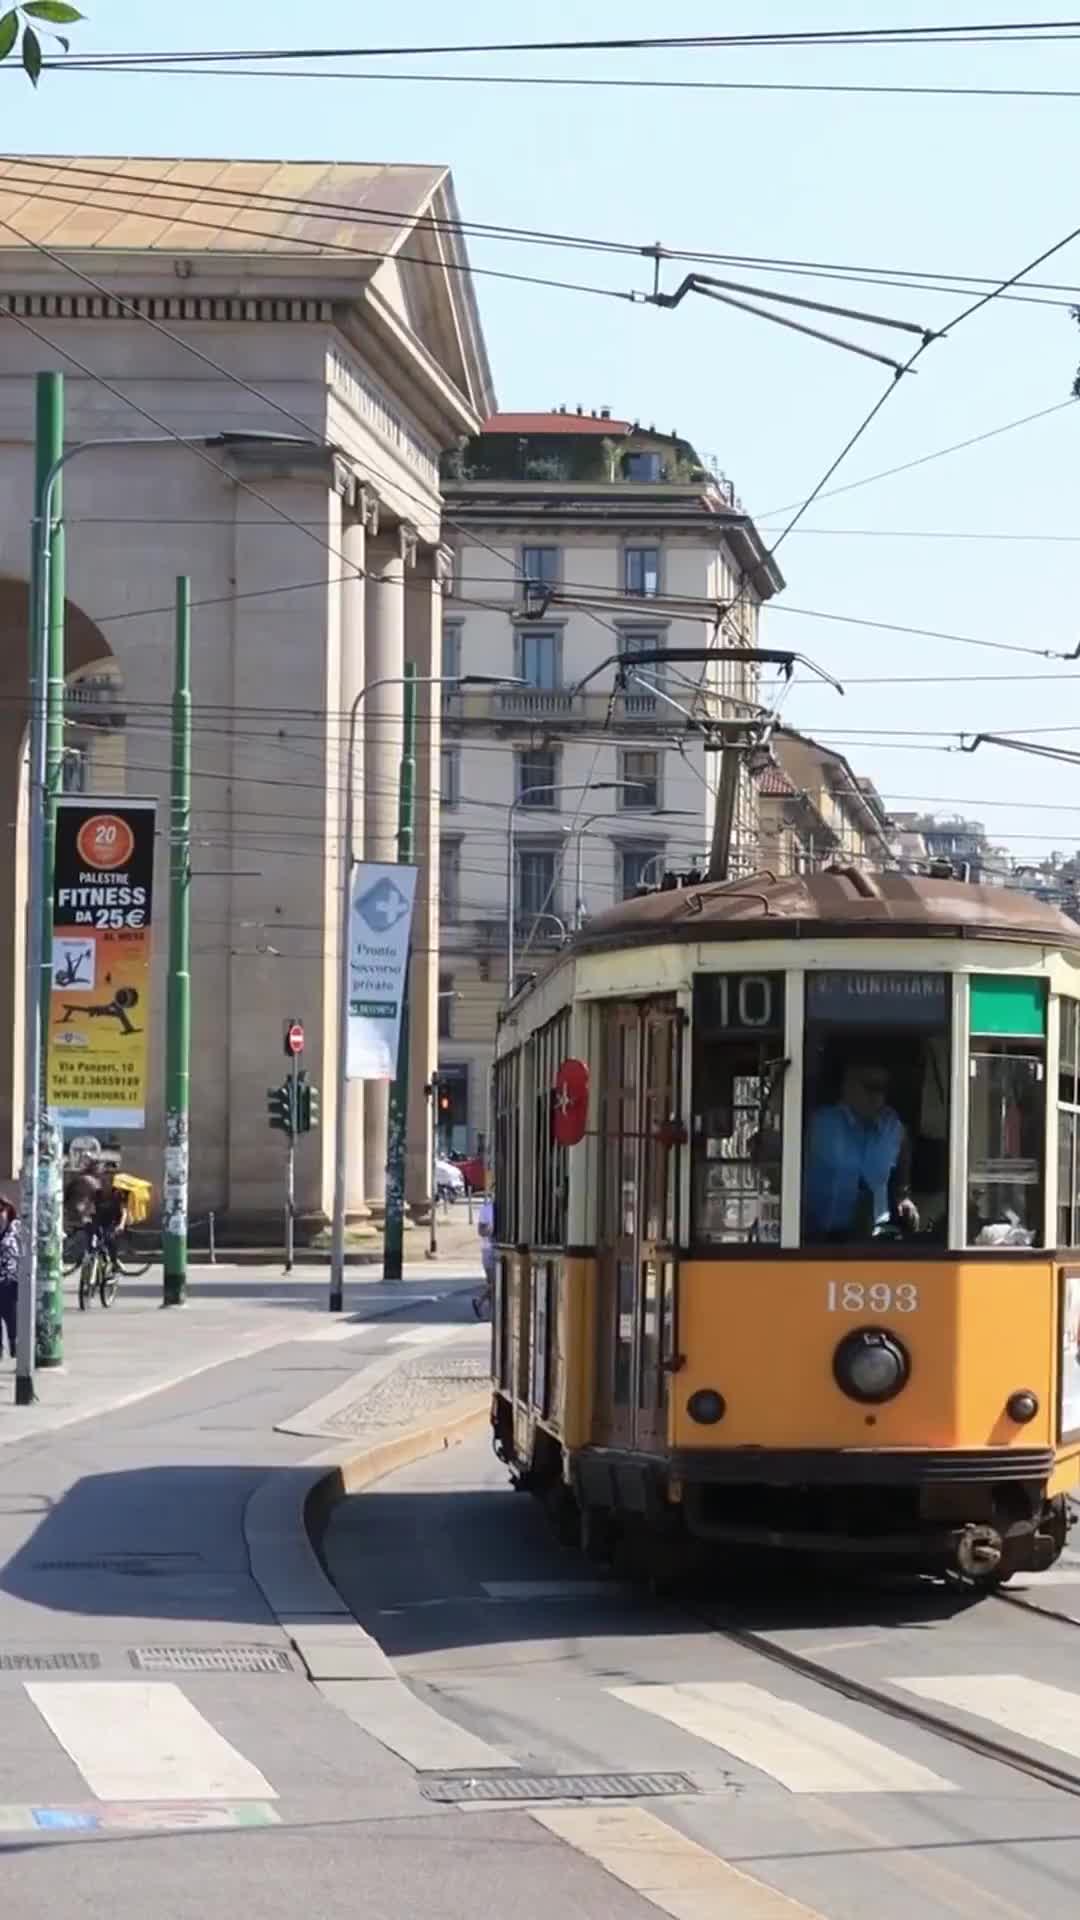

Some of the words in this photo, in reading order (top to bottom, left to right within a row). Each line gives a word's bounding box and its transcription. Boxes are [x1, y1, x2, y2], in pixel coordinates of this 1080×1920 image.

[95, 825, 117, 843] 20
[79, 872, 129, 884] PALESTRE
[58, 887, 146, 907] FITNESS
[75, 911, 93, 923] DA
[95, 908, 145, 929] 25€
[357, 944, 397, 956] Pronto
[353, 979, 394, 992] privato
[717, 975, 772, 1028] 10
[59, 1061, 75, 1072] Via
[825, 1280, 919, 1313] 1893
